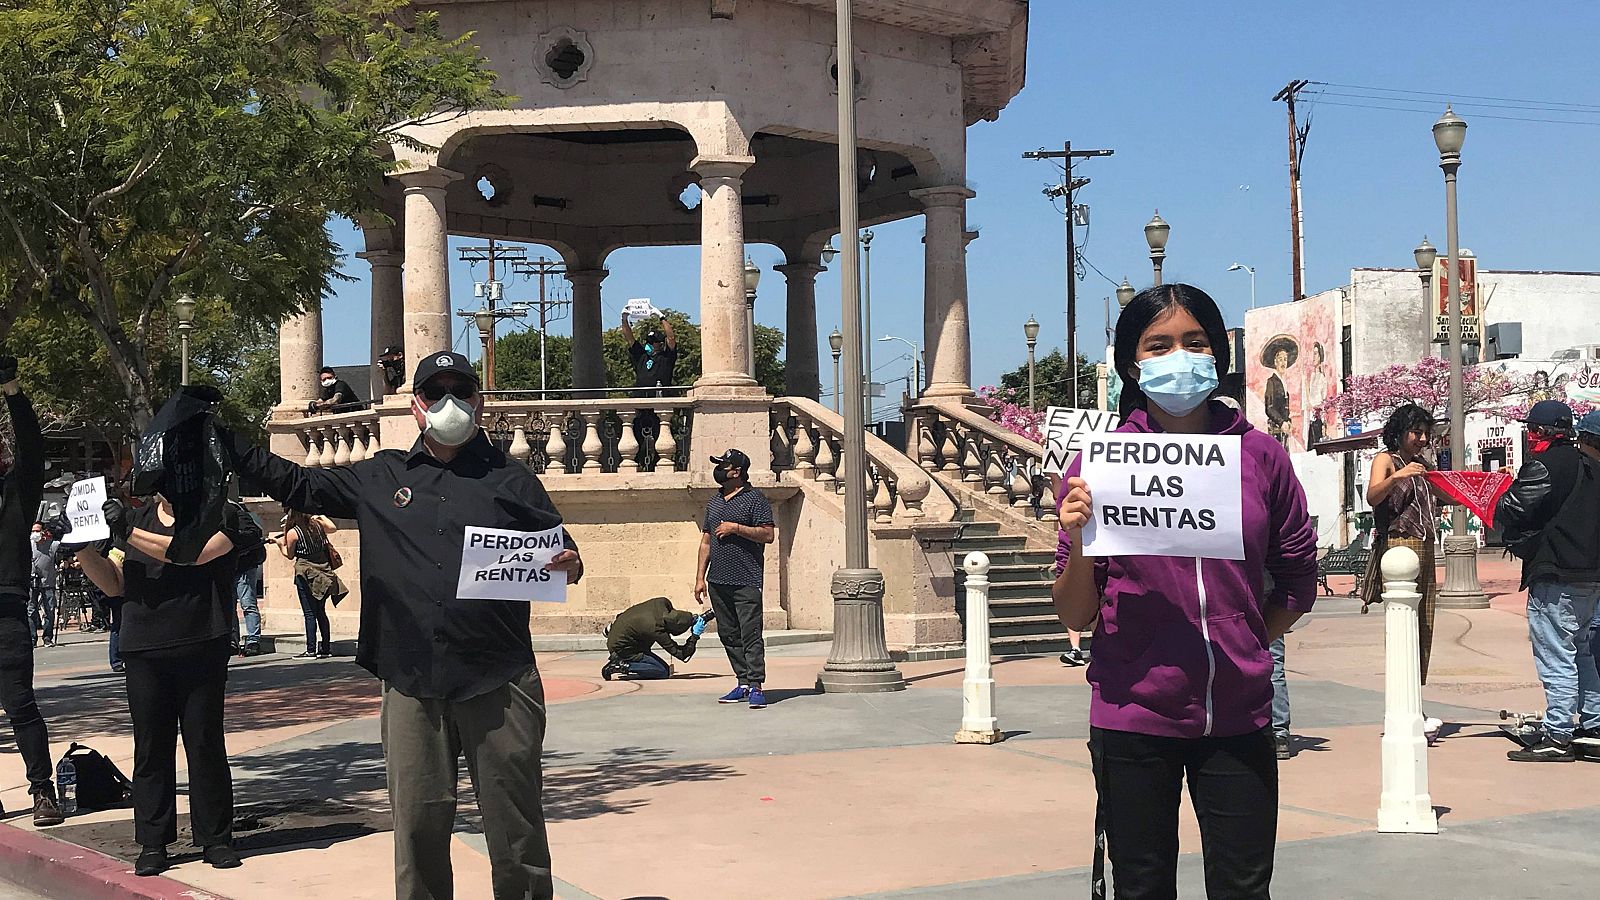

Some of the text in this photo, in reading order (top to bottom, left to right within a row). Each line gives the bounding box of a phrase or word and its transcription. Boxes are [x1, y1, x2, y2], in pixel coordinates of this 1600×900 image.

[1045, 429, 1084, 451] RE
[1486, 426, 1505, 438] 1707
[1089, 441, 1225, 467] PERDONA
[1130, 474, 1184, 498] LAS
[76, 499, 89, 512] NO
[73, 513, 100, 528] RENTA
[1102, 505, 1216, 531] RENTAS
[470, 532, 561, 550] PERDONA
[498, 552, 534, 564] LAS
[474, 567, 551, 583] RENTAS
